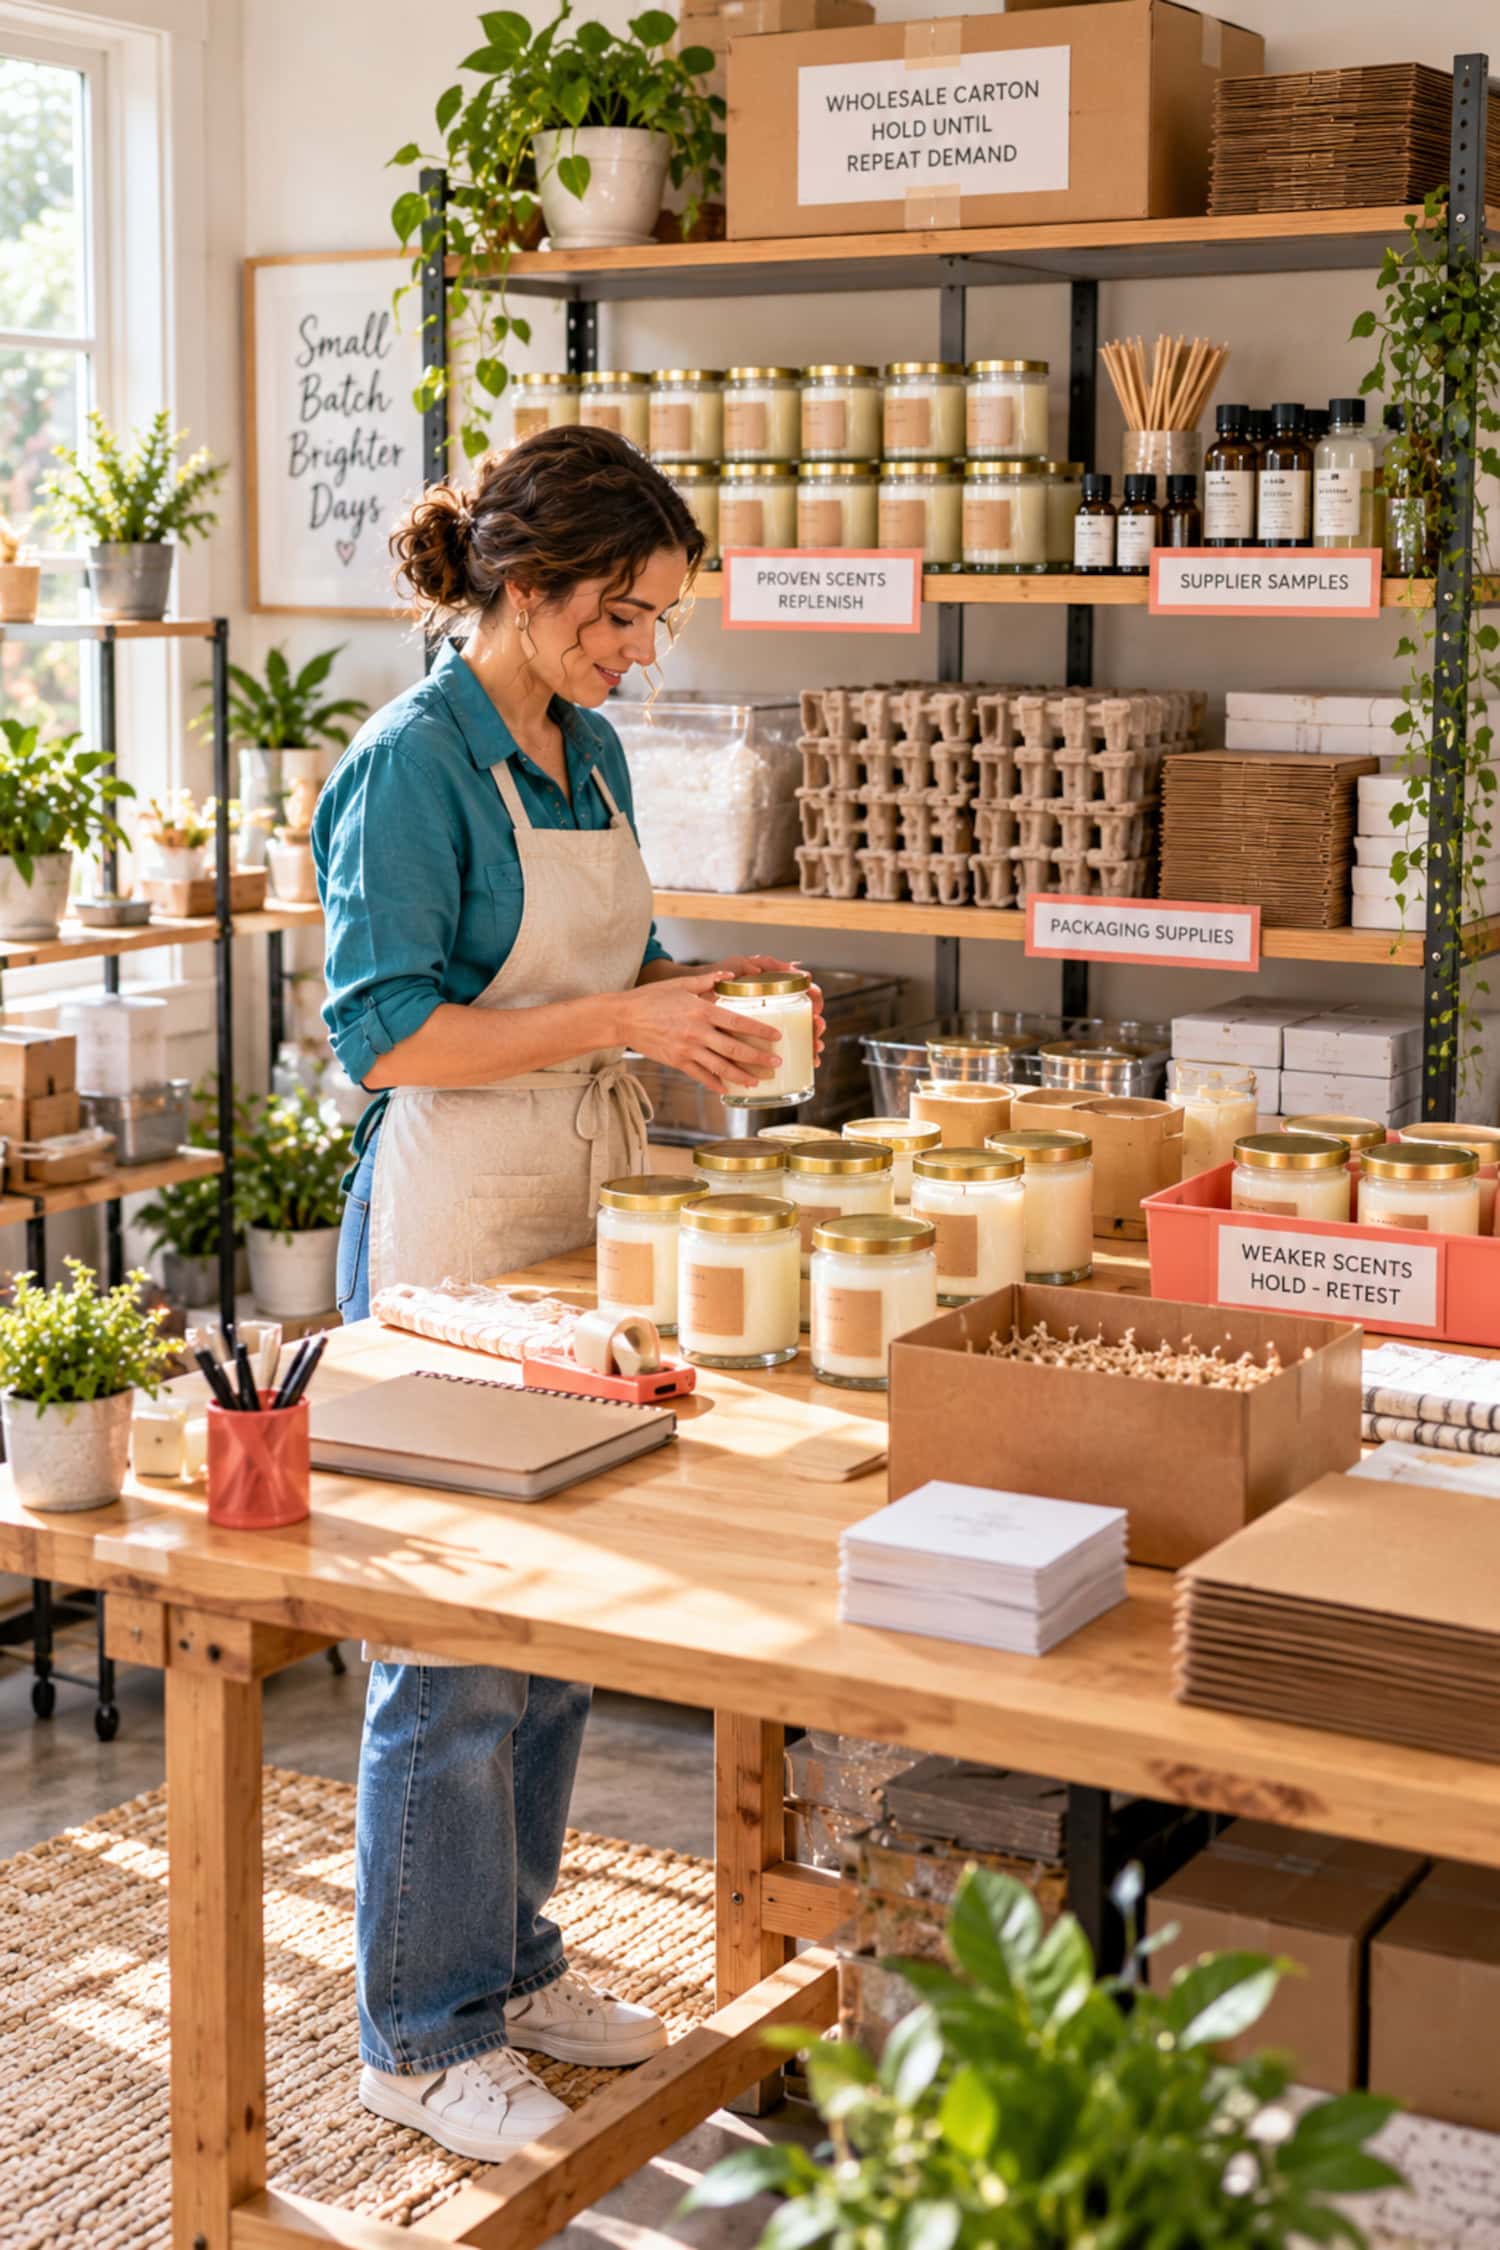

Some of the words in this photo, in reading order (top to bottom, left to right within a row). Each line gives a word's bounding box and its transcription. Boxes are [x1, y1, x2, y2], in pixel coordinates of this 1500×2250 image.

[825, 86, 947, 113] WHOLESALE
[953, 79, 1039, 104] CARTON
[871, 119, 927, 141] HOLD
[933, 114, 993, 137] UNTIL
[847, 149, 921, 173] REPEAT
[927, 144, 1018, 168] DEMAND
[295, 311, 391, 368] Small
[299, 369, 391, 423] Batch
[287, 426, 404, 487] Brighter
[309, 482, 383, 539] Days
[757, 570, 821, 587] PROVEN
[825, 571, 887, 588] SCENTS
[1180, 573, 1262, 590] SUPPLIER
[1267, 573, 1349, 591] SAMPLES
[778, 593, 864, 610] REPLENISH
[1050, 917, 1151, 939] PACKAGING
[1155, 924, 1234, 945] SUPPLIES
[1241, 1243, 1326, 1269] WEAKER
[1332, 1253, 1413, 1279] SCENTS
[1250, 1272, 1307, 1295] HOLD
[1326, 1280, 1401, 1305] RETEST
